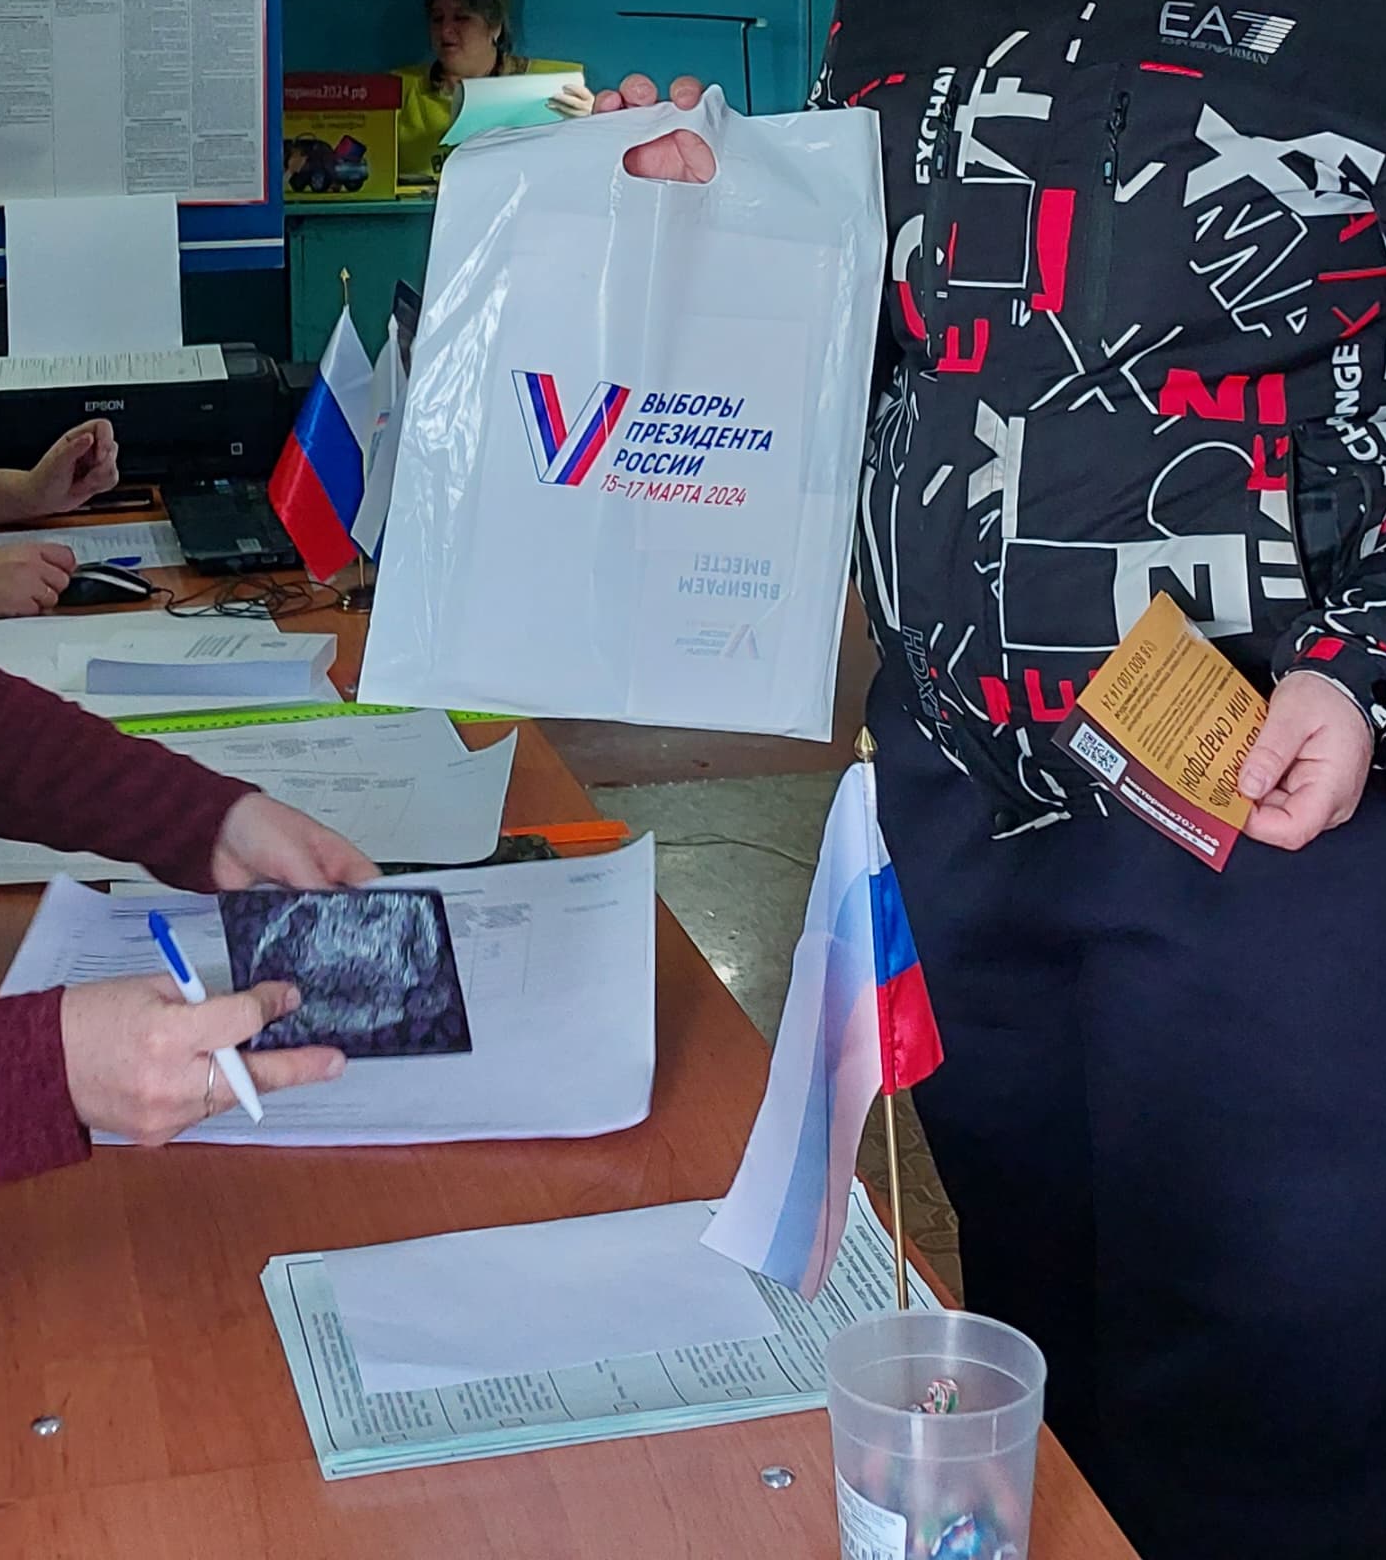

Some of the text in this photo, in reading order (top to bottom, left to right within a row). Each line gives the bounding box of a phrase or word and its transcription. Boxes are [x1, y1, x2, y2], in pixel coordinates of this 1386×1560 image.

[85, 400, 124, 412] EPSON
[639, 393, 745, 419] ВЫБОРЫ
[625, 421, 773, 451] ПРЕЗИДЕНТА
[613, 447, 705, 477] РОССИИ
[644, 481, 702, 504] МАРТА
[704, 486, 746, 507] 2024
[678, 576, 781, 600] ВЫБИРАЕМ
[1228, 686, 1253, 721] или
[1177, 719, 1233, 800] смартфон!
[1124, 775, 1221, 848] викторина2024.рф
